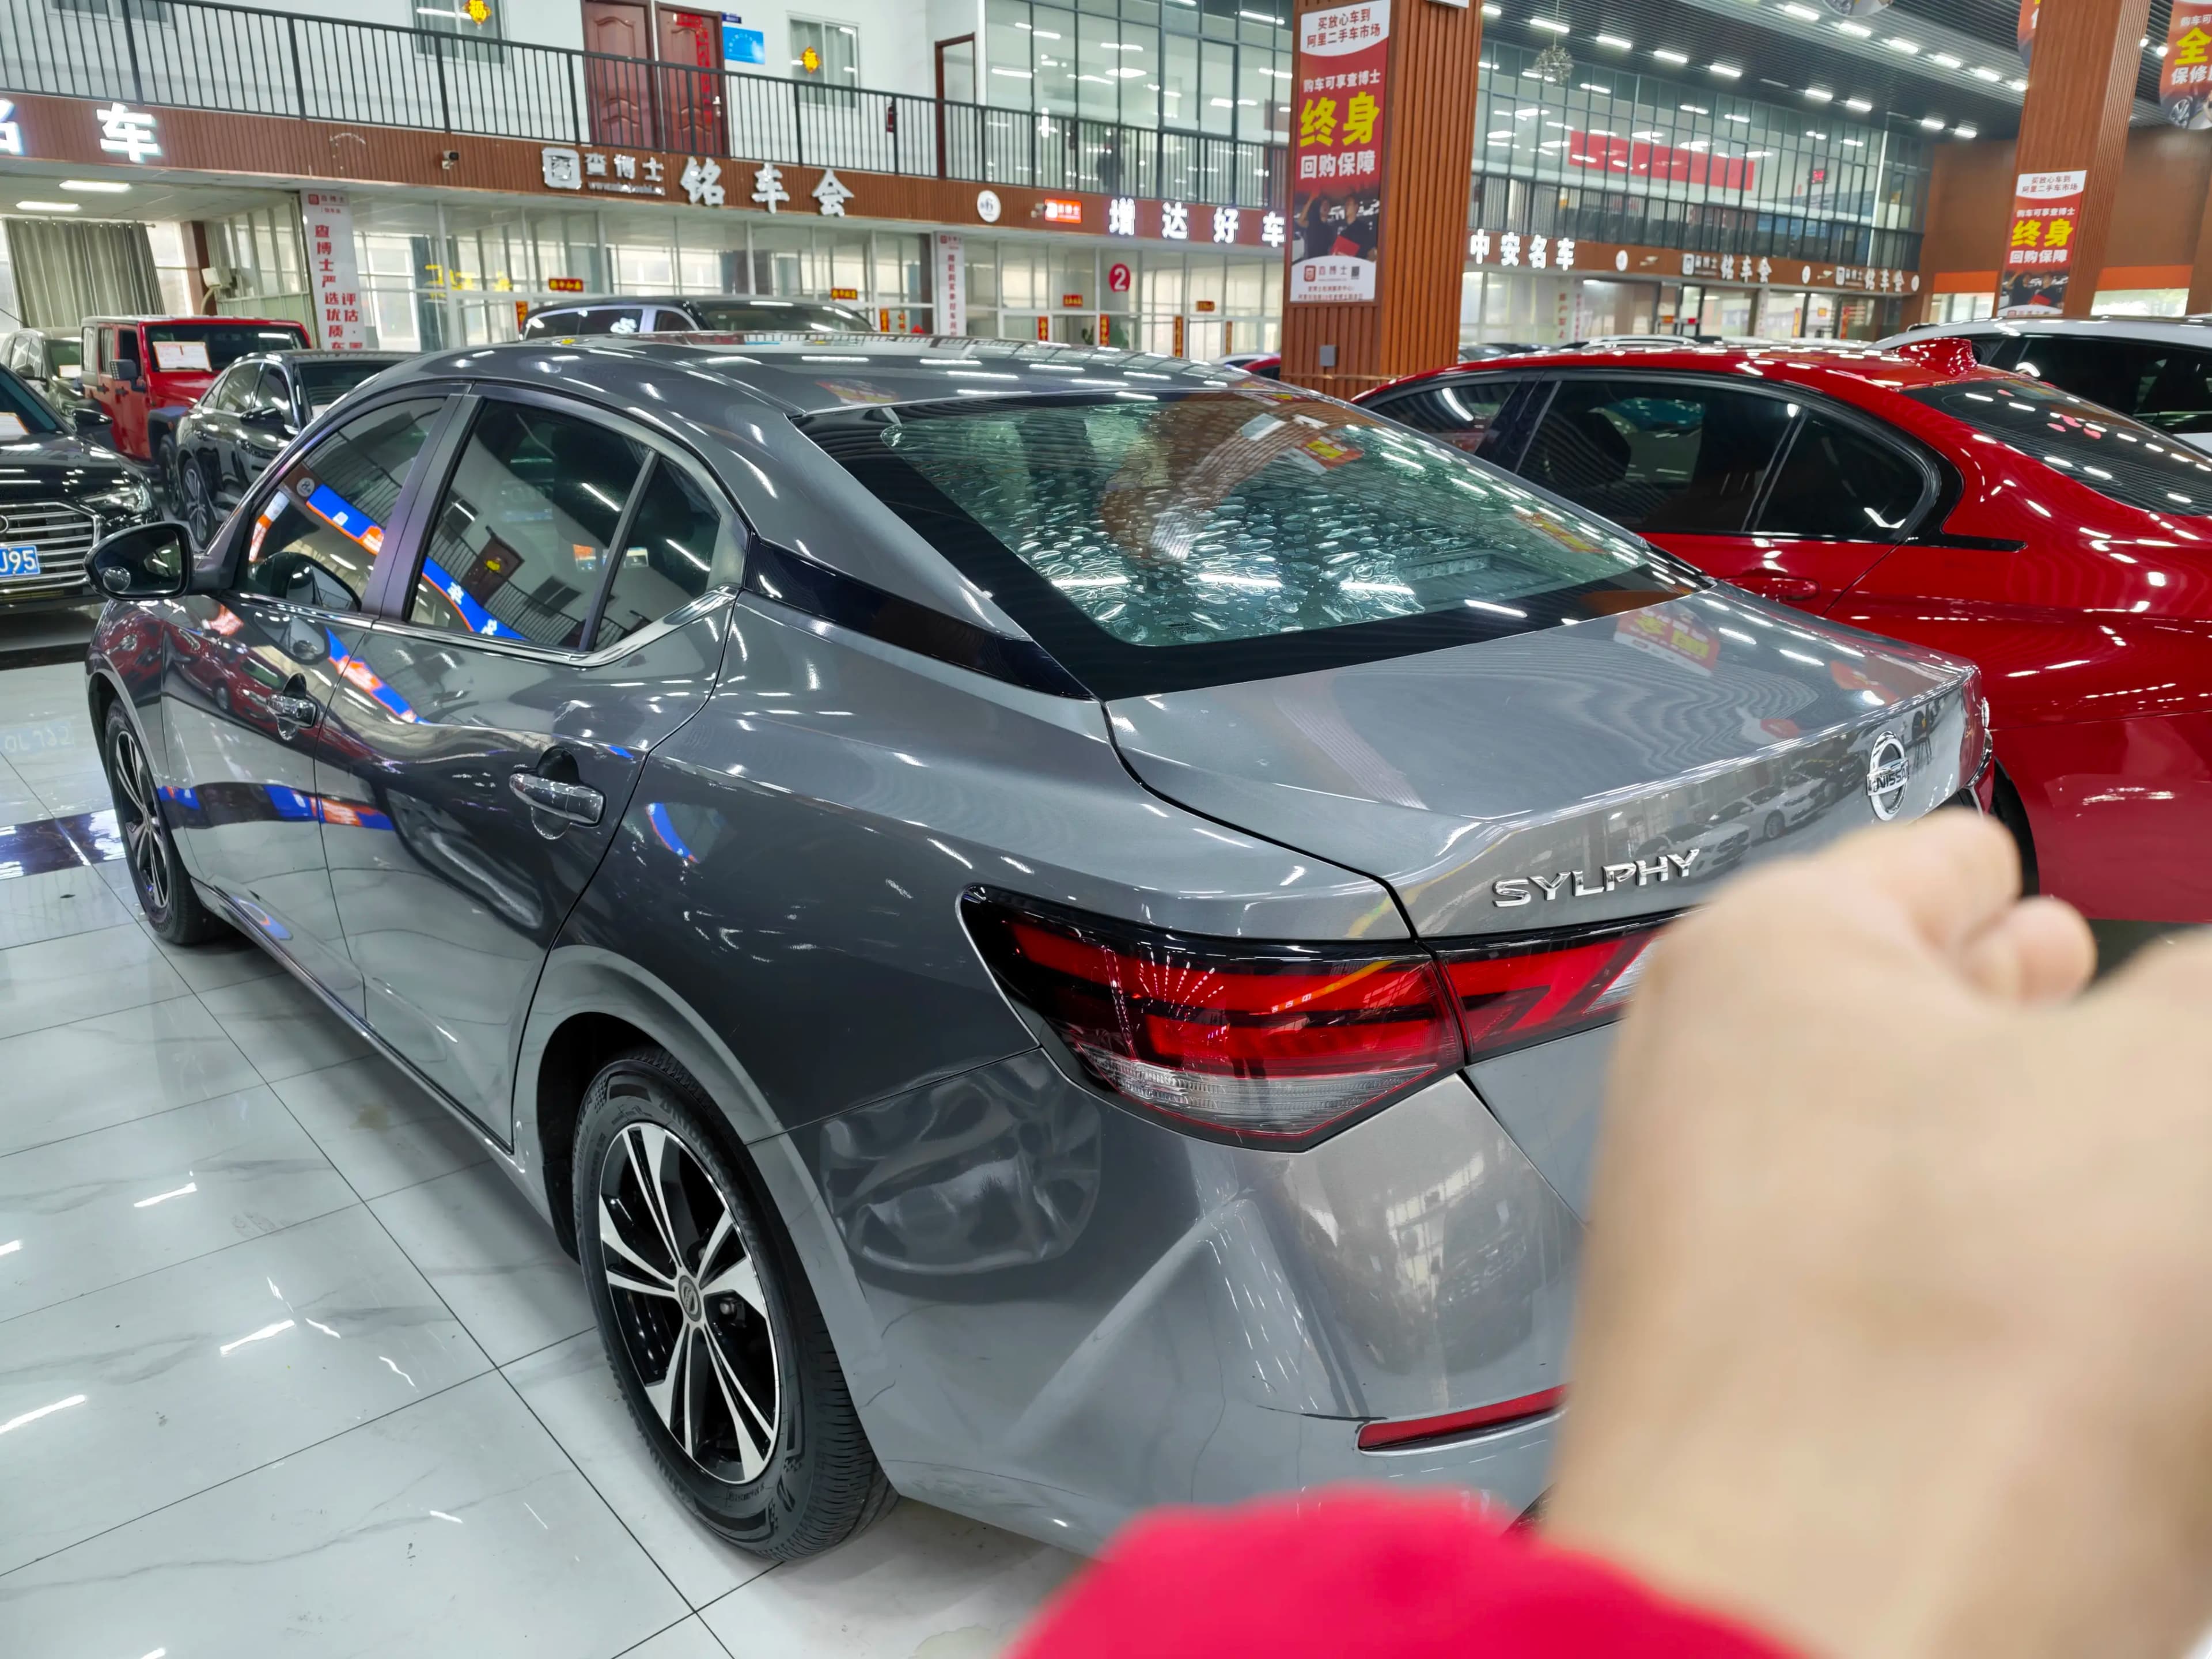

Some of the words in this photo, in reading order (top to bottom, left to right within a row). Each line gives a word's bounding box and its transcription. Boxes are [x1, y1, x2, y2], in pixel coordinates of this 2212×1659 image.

[1317, 7, 1370, 31] 买放心车到
[1306, 23, 1381, 48] 阿里二手车市场
[1303, 69, 1381, 93] 购车可享查博士
[2171, 66, 2212, 85] 保修
[1300, 91, 1380, 148] 终身
[1300, 149, 1376, 180] 回购保障
[680, 156, 855, 218] 铭车会
[1108, 197, 1285, 248] 增达好车
[2011, 219, 2073, 247] 终身
[1469, 228, 1575, 271] 中安名车
[2009, 250, 2067, 264] 回购保障
[1115, 268, 1126, 290] 2
[1492, 849, 1700, 908] SYLPHY
